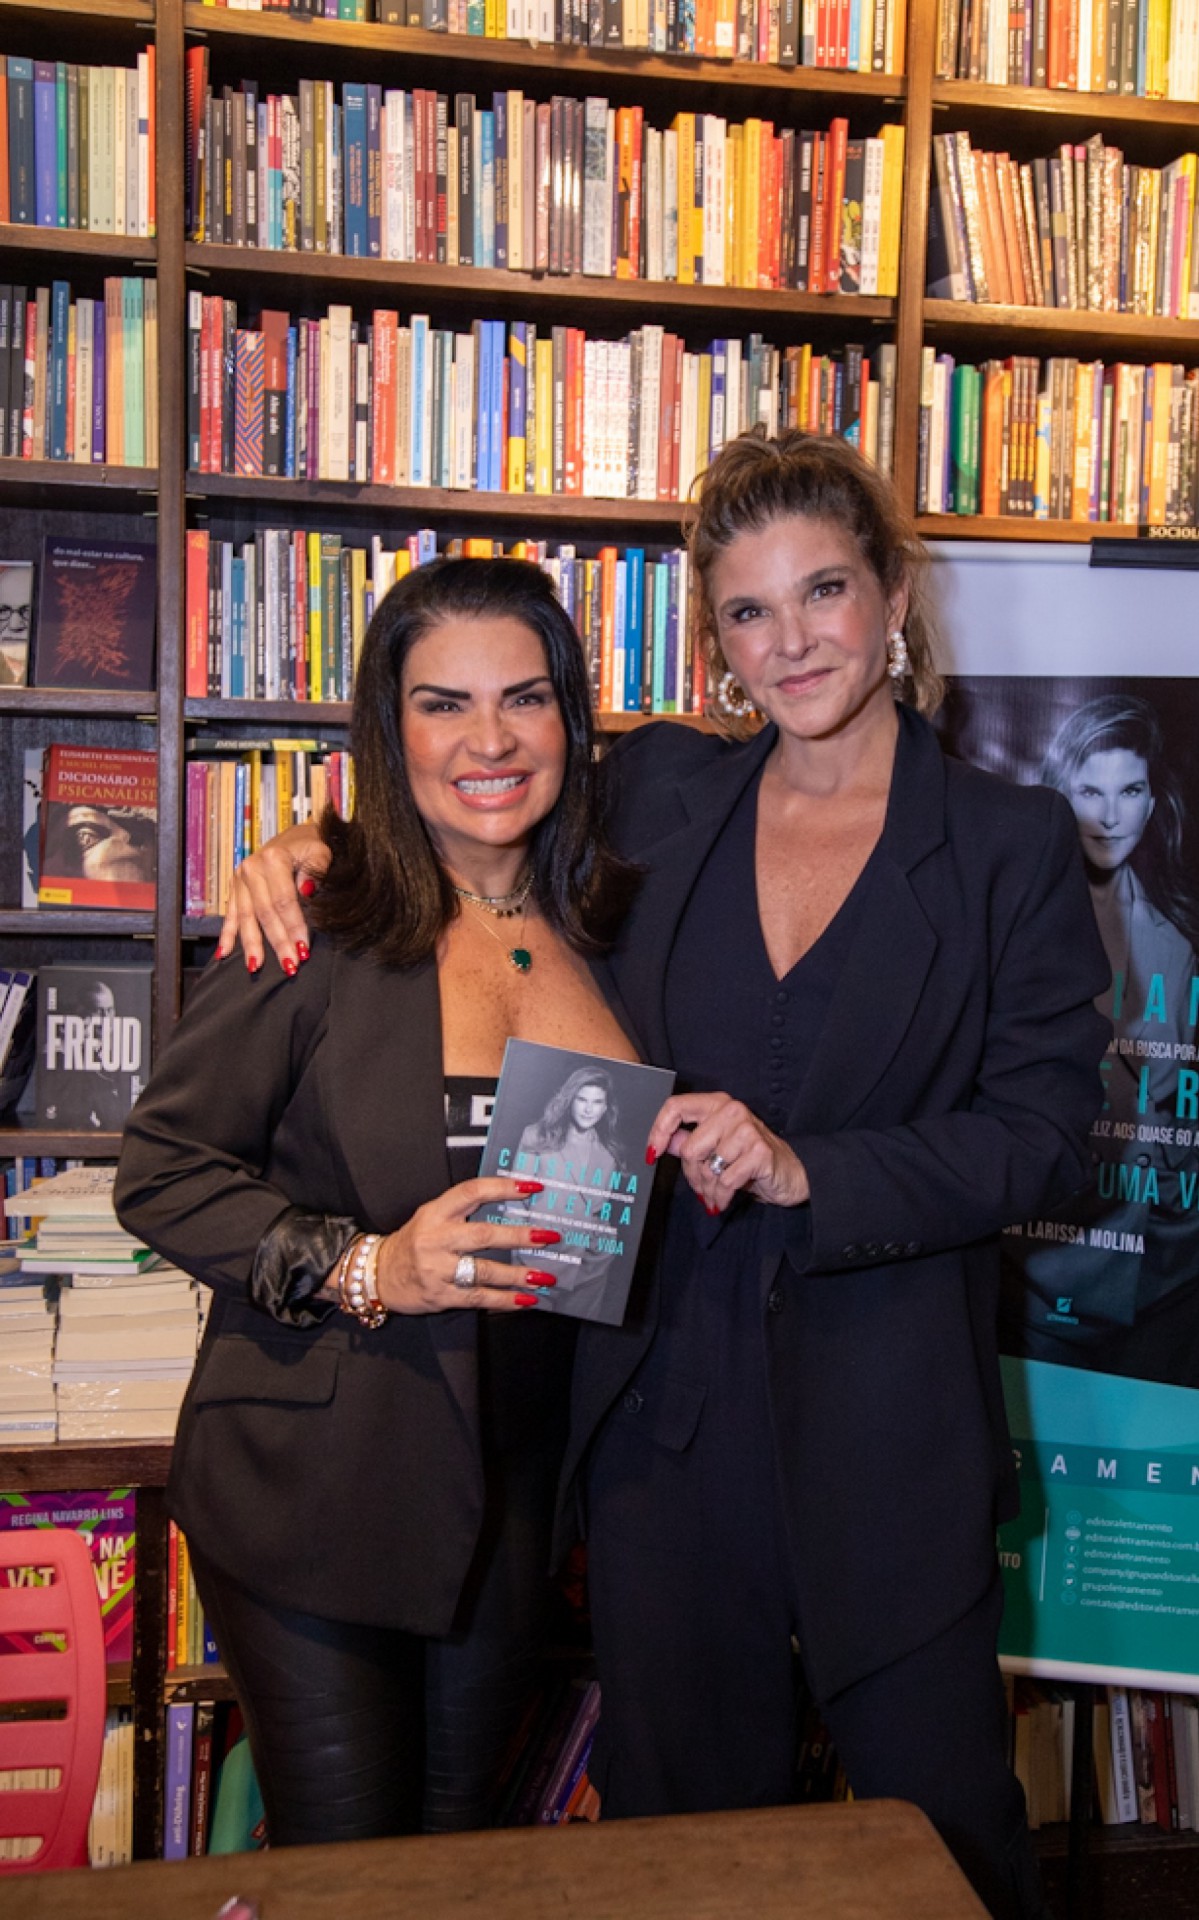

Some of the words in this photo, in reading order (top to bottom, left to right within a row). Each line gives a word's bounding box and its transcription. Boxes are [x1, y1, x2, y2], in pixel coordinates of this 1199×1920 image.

[58, 771, 138, 787] DICIONÁRIO
[46, 1014, 142, 1073] FREUD
[1136, 1039, 1171, 1059] BUSCA
[1173, 1042, 1196, 1061] POR
[1113, 1121, 1135, 1140] AOS
[1136, 1124, 1174, 1145] QUASE
[1175, 1127, 1192, 1147] 60
[498, 1147, 638, 1194] CRISTIANA
[1098, 1161, 1160, 1206] UMA
[564, 1231, 590, 1249] UMA
[597, 1237, 624, 1256] VIDA
[1027, 1220, 1086, 1245] LARISSA
[1089, 1227, 1146, 1255] MOLINA
[11, 1511, 50, 1527] REGINA
[52, 1508, 99, 1524] NAVARRO
[101, 1507, 125, 1520] LINS
[99, 1535, 127, 1561] NA
